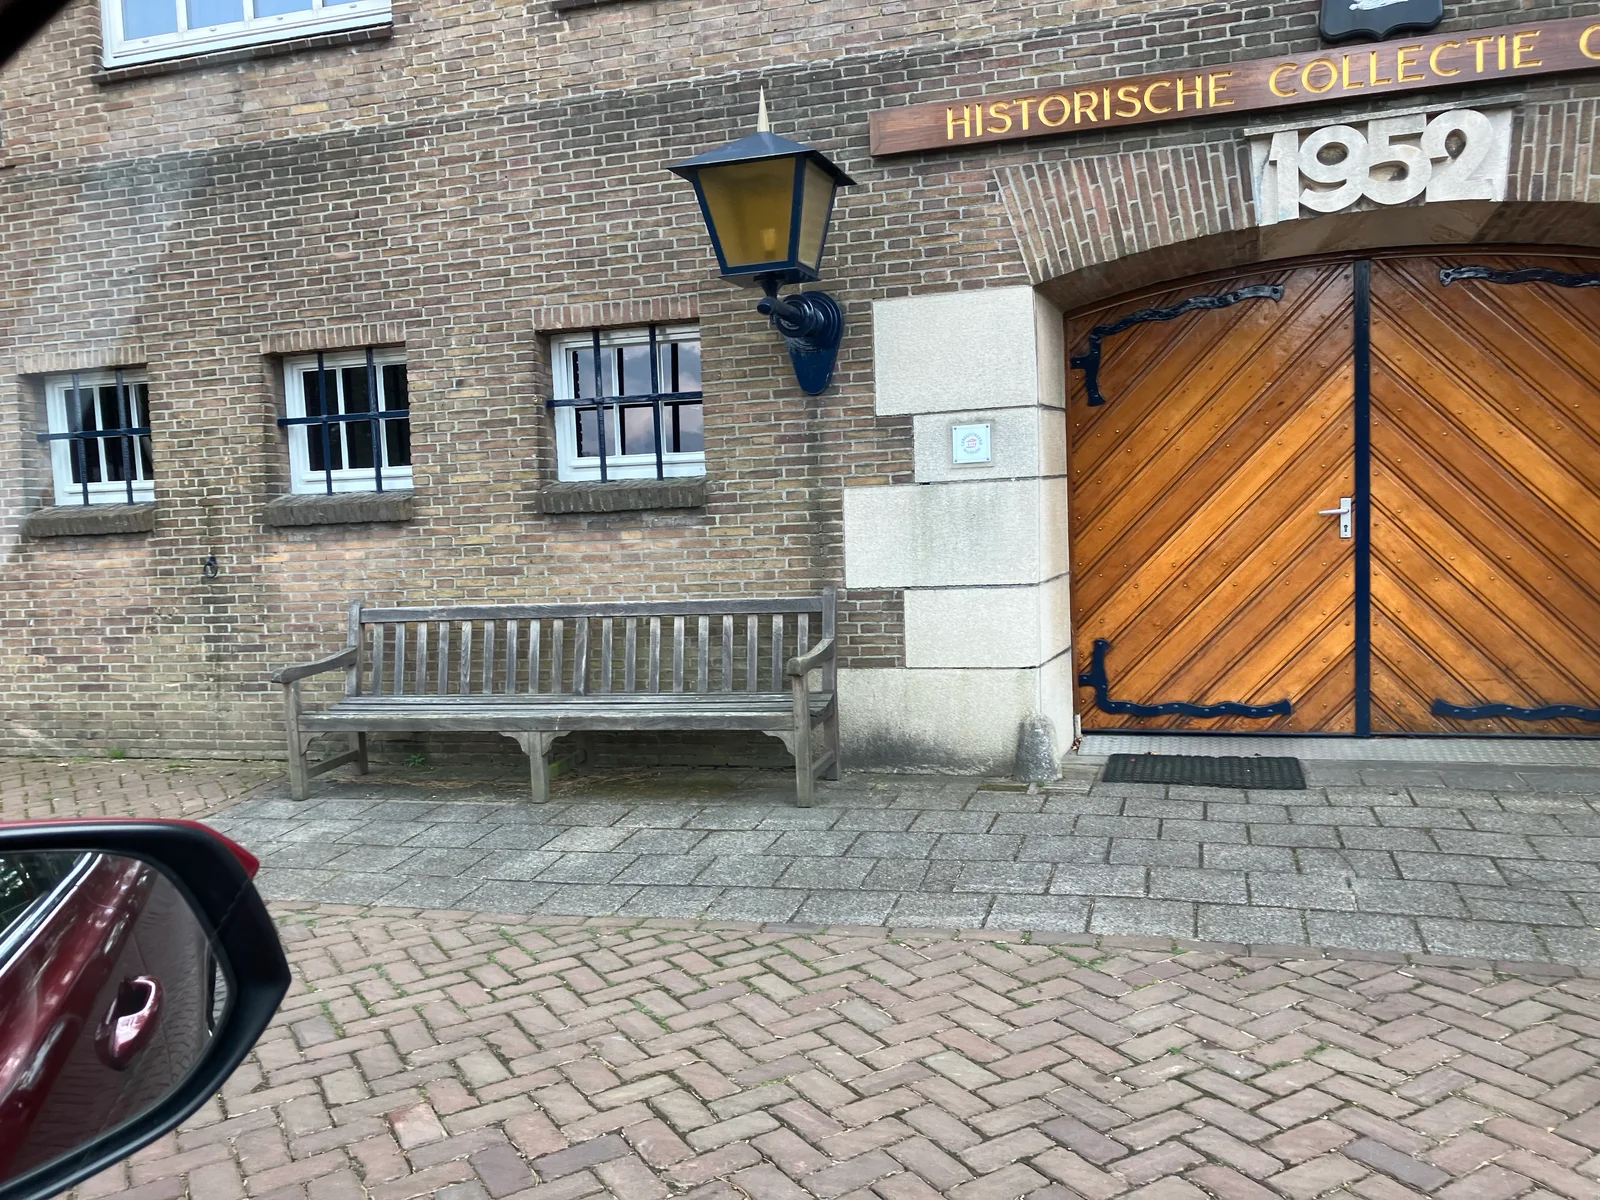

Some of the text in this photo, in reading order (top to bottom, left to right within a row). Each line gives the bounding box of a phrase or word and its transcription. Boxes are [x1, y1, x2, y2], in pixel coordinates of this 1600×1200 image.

[945, 72, 1236, 140] HISTORISCHE
[1268, 30, 1543, 98] COLLECTIE
[1268, 108, 1496, 222] 1952
